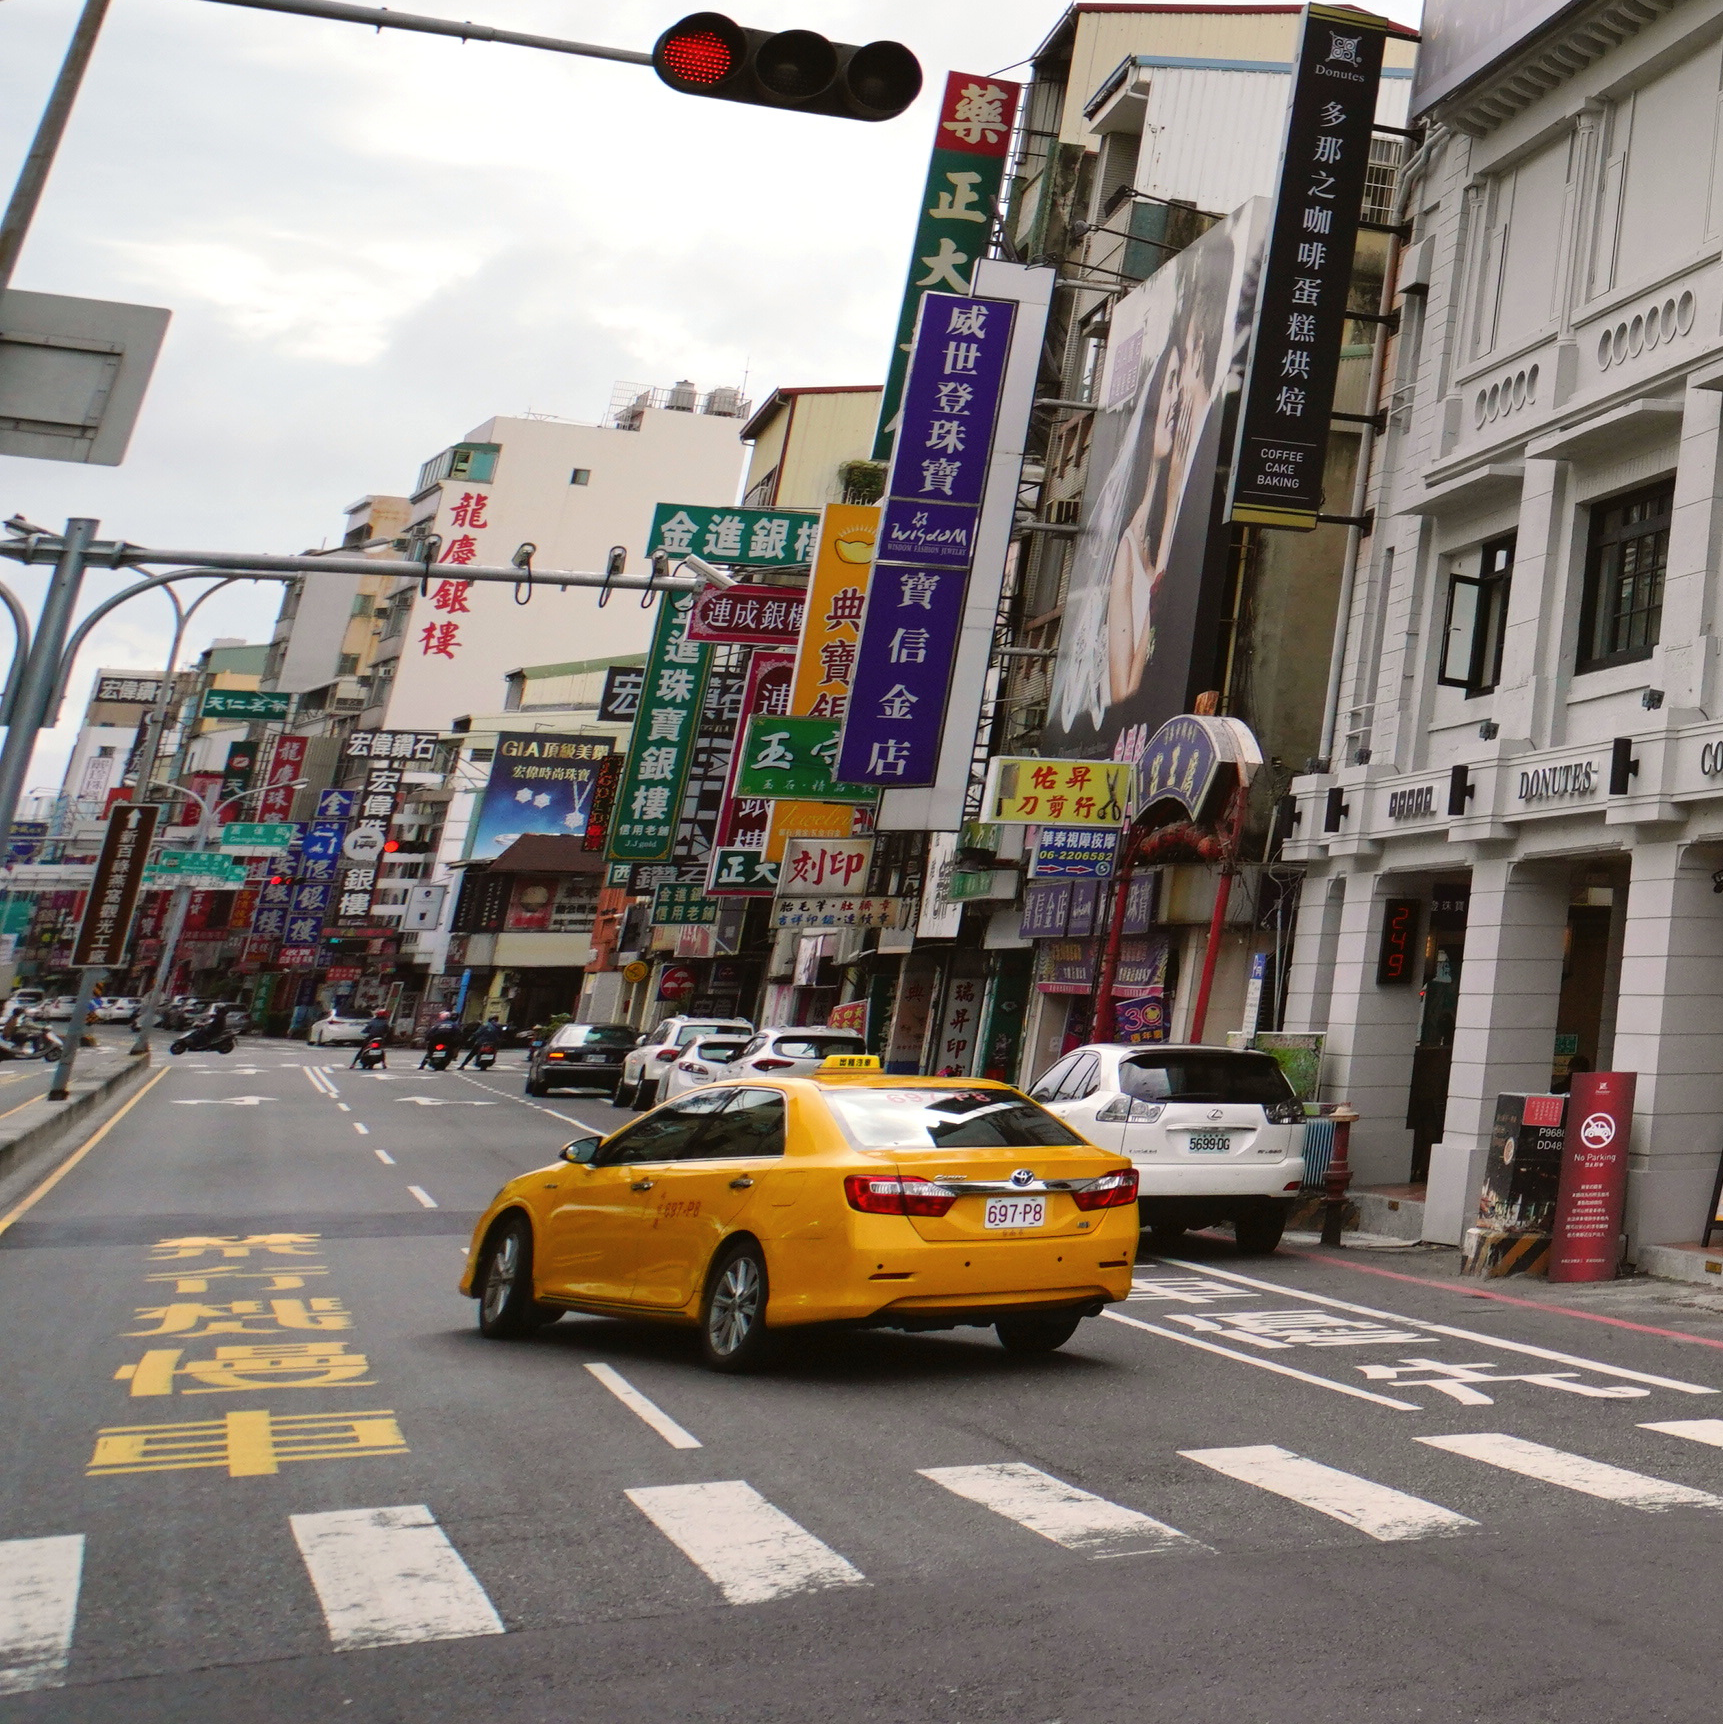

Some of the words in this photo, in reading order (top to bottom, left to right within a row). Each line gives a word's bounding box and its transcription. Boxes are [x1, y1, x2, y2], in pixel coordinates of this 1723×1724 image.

[1314, 62, 1366, 84] Donutes
[943, 83, 1008, 145] 藥
[1275, 101, 1347, 418] 多那之咖啡蛋糕烘焙
[918, 304, 989, 496] 威世登珠寶
[1260, 447, 1304, 463] COFFEE
[1265, 462, 1296, 476] CAKE
[1256, 475, 1300, 490] BAKING
[418, 492, 488, 660] 龍慶銀樓
[865, 572, 942, 777] 寶信金店
[347, 732, 435, 759] 宏偉鑽石
[502, 740, 540, 758] GIA
[511, 764, 592, 782] 宏偉時尚珠寶
[1030, 766, 1093, 792] 佑昇
[1518, 761, 1593, 800] DONUTES
[1016, 795, 1096, 820] 刀剪行
[1041, 830, 1116, 850] 華泰視障按摩
[1038, 850, 1114, 862] 06-2206582
[788, 848, 865, 887] 刻印
[1537, 1140, 1565, 1151] DD48
[1574, 1153, 1585, 1162] No
[1586, 1153, 1617, 1164] Parking
[987, 1204, 1043, 1225] 697-P8
